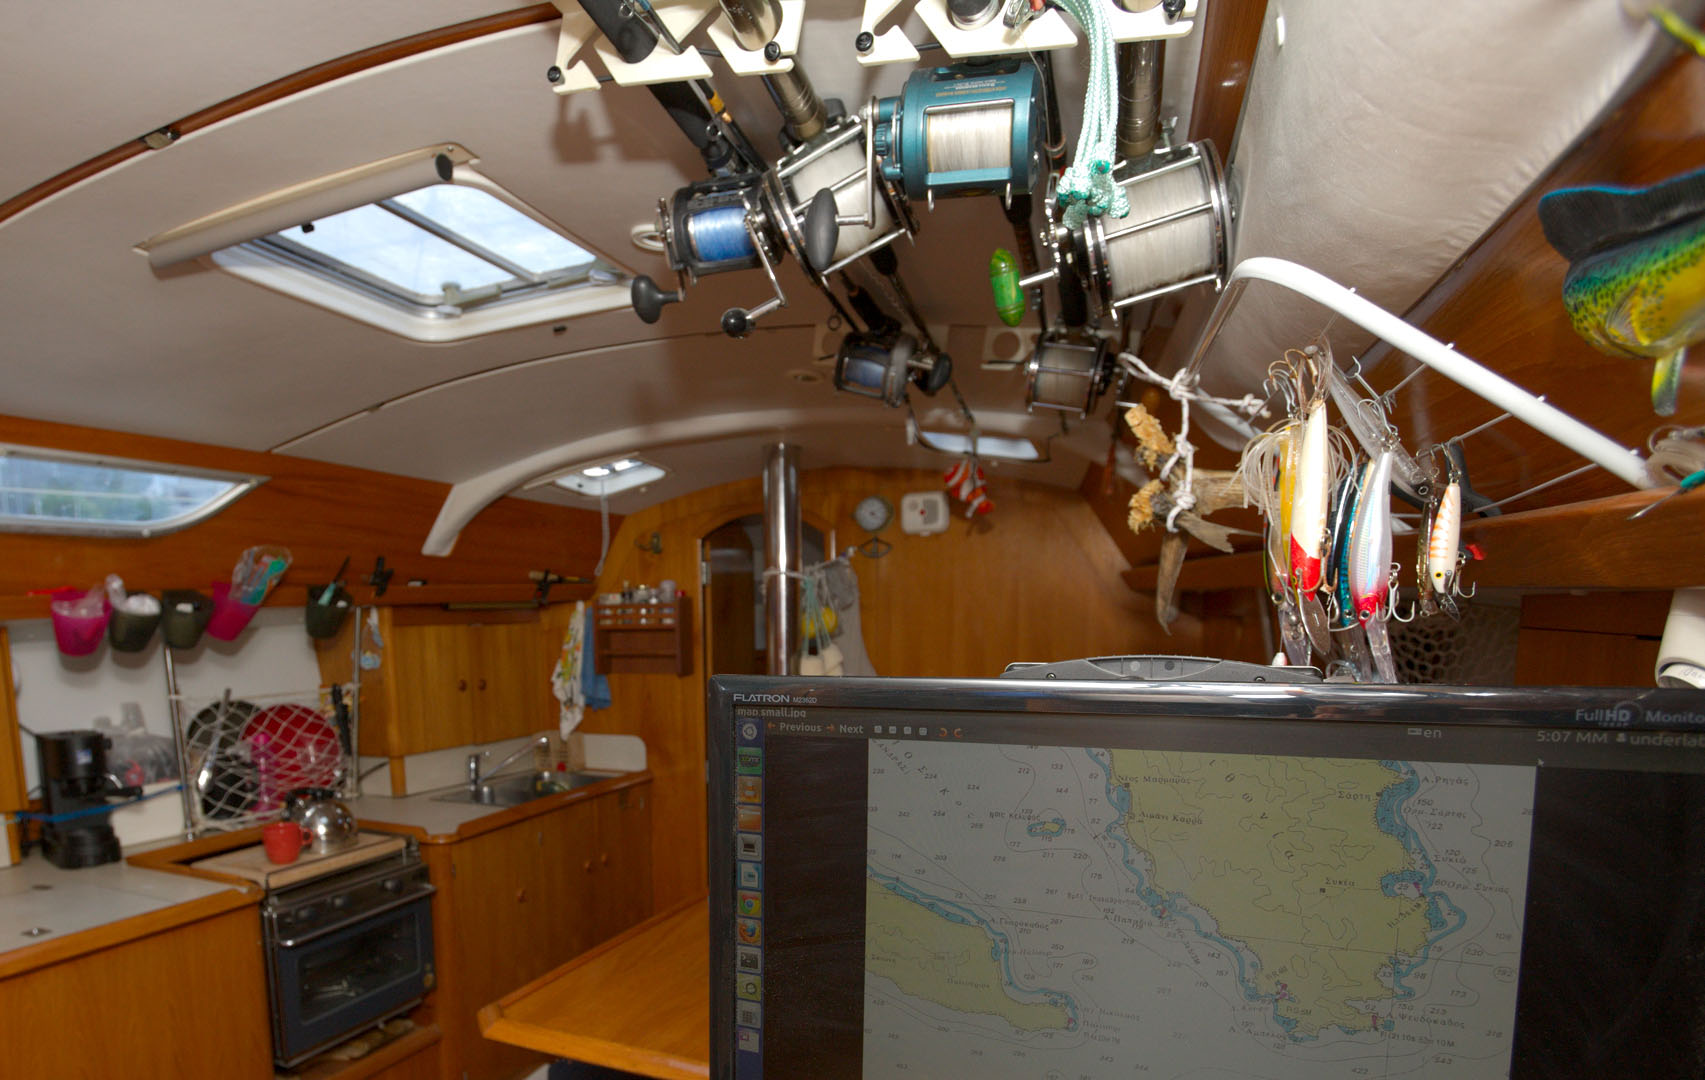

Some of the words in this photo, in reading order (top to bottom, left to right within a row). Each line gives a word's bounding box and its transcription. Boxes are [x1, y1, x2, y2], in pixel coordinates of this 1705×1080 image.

[733, 693, 790, 704] FLATRON
[779, 722, 822, 733] Previous
[839, 724, 864, 734] Next
[1423, 729, 1442, 738] en
[1536, 730, 1570, 743] 5:07
[1576, 732, 1608, 744] MM
